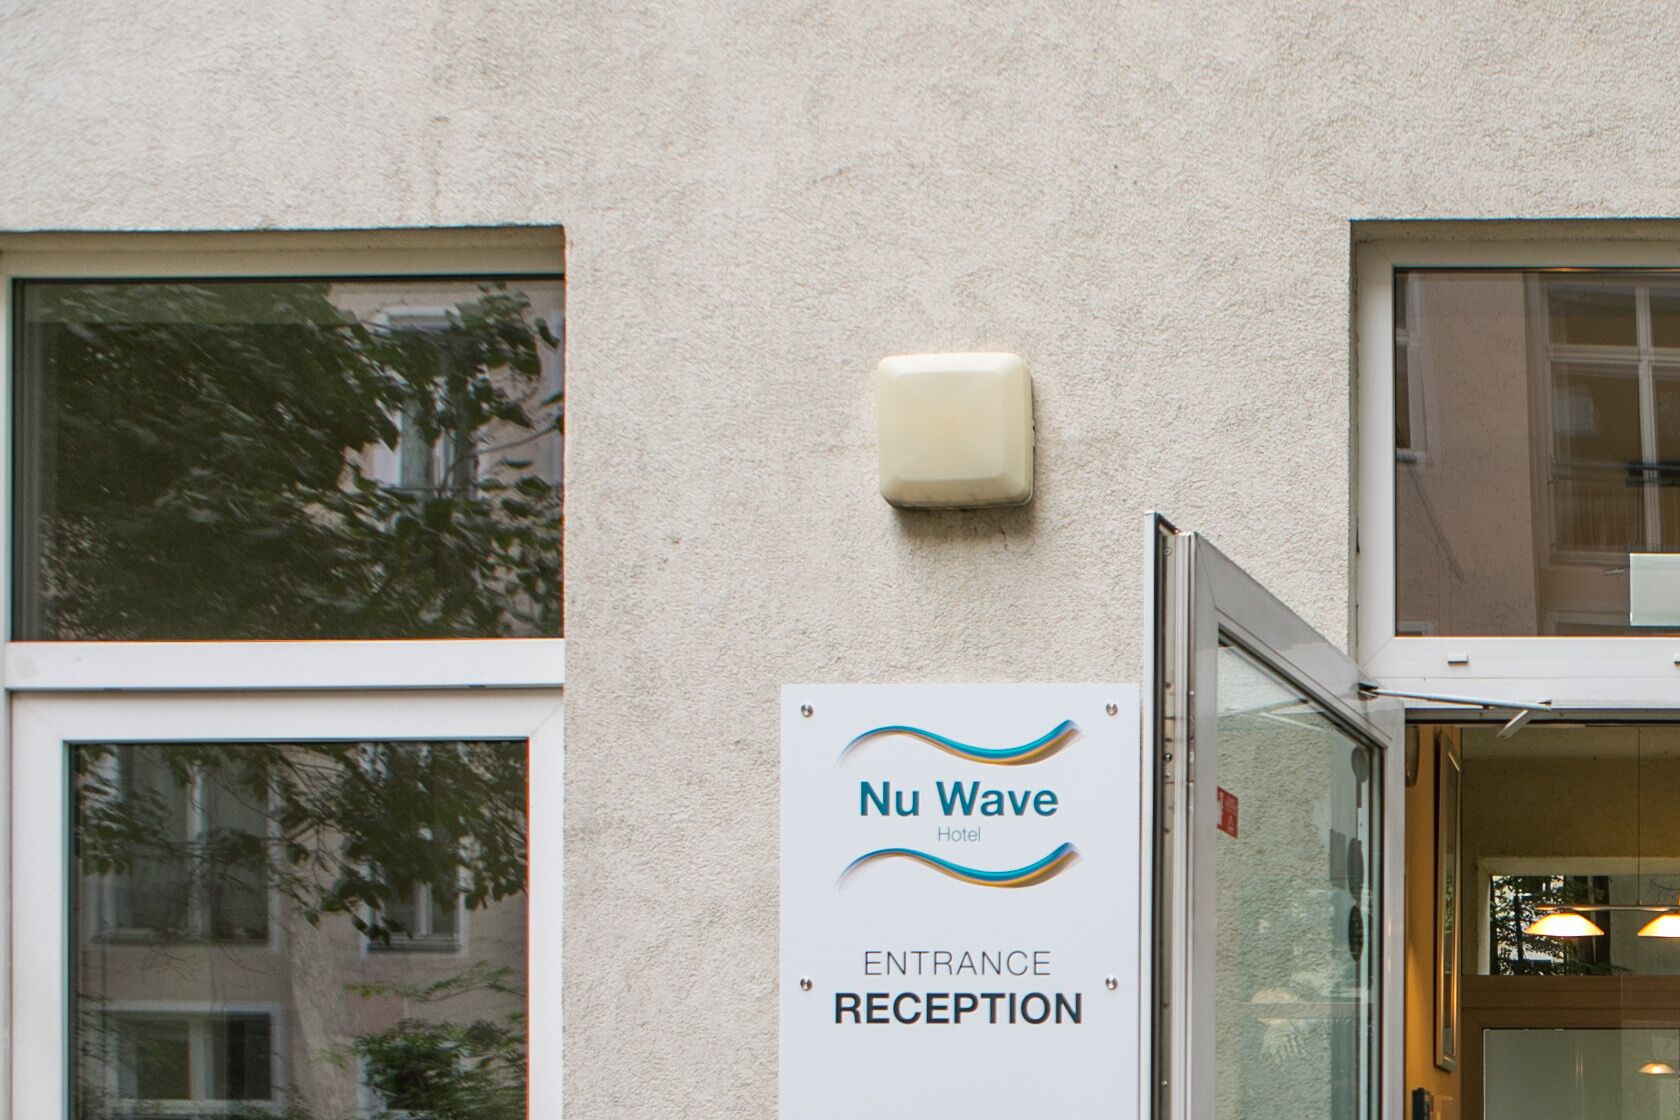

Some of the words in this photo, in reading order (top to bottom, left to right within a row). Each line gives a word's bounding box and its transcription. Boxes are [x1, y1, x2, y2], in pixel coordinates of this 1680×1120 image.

[859, 780, 920, 817] Nu
[935, 780, 1059, 817] Wave
[937, 825, 982, 843] Hotel
[863, 950, 1052, 976] ENTRANCE
[833, 992, 1083, 1025] RECEPTION
